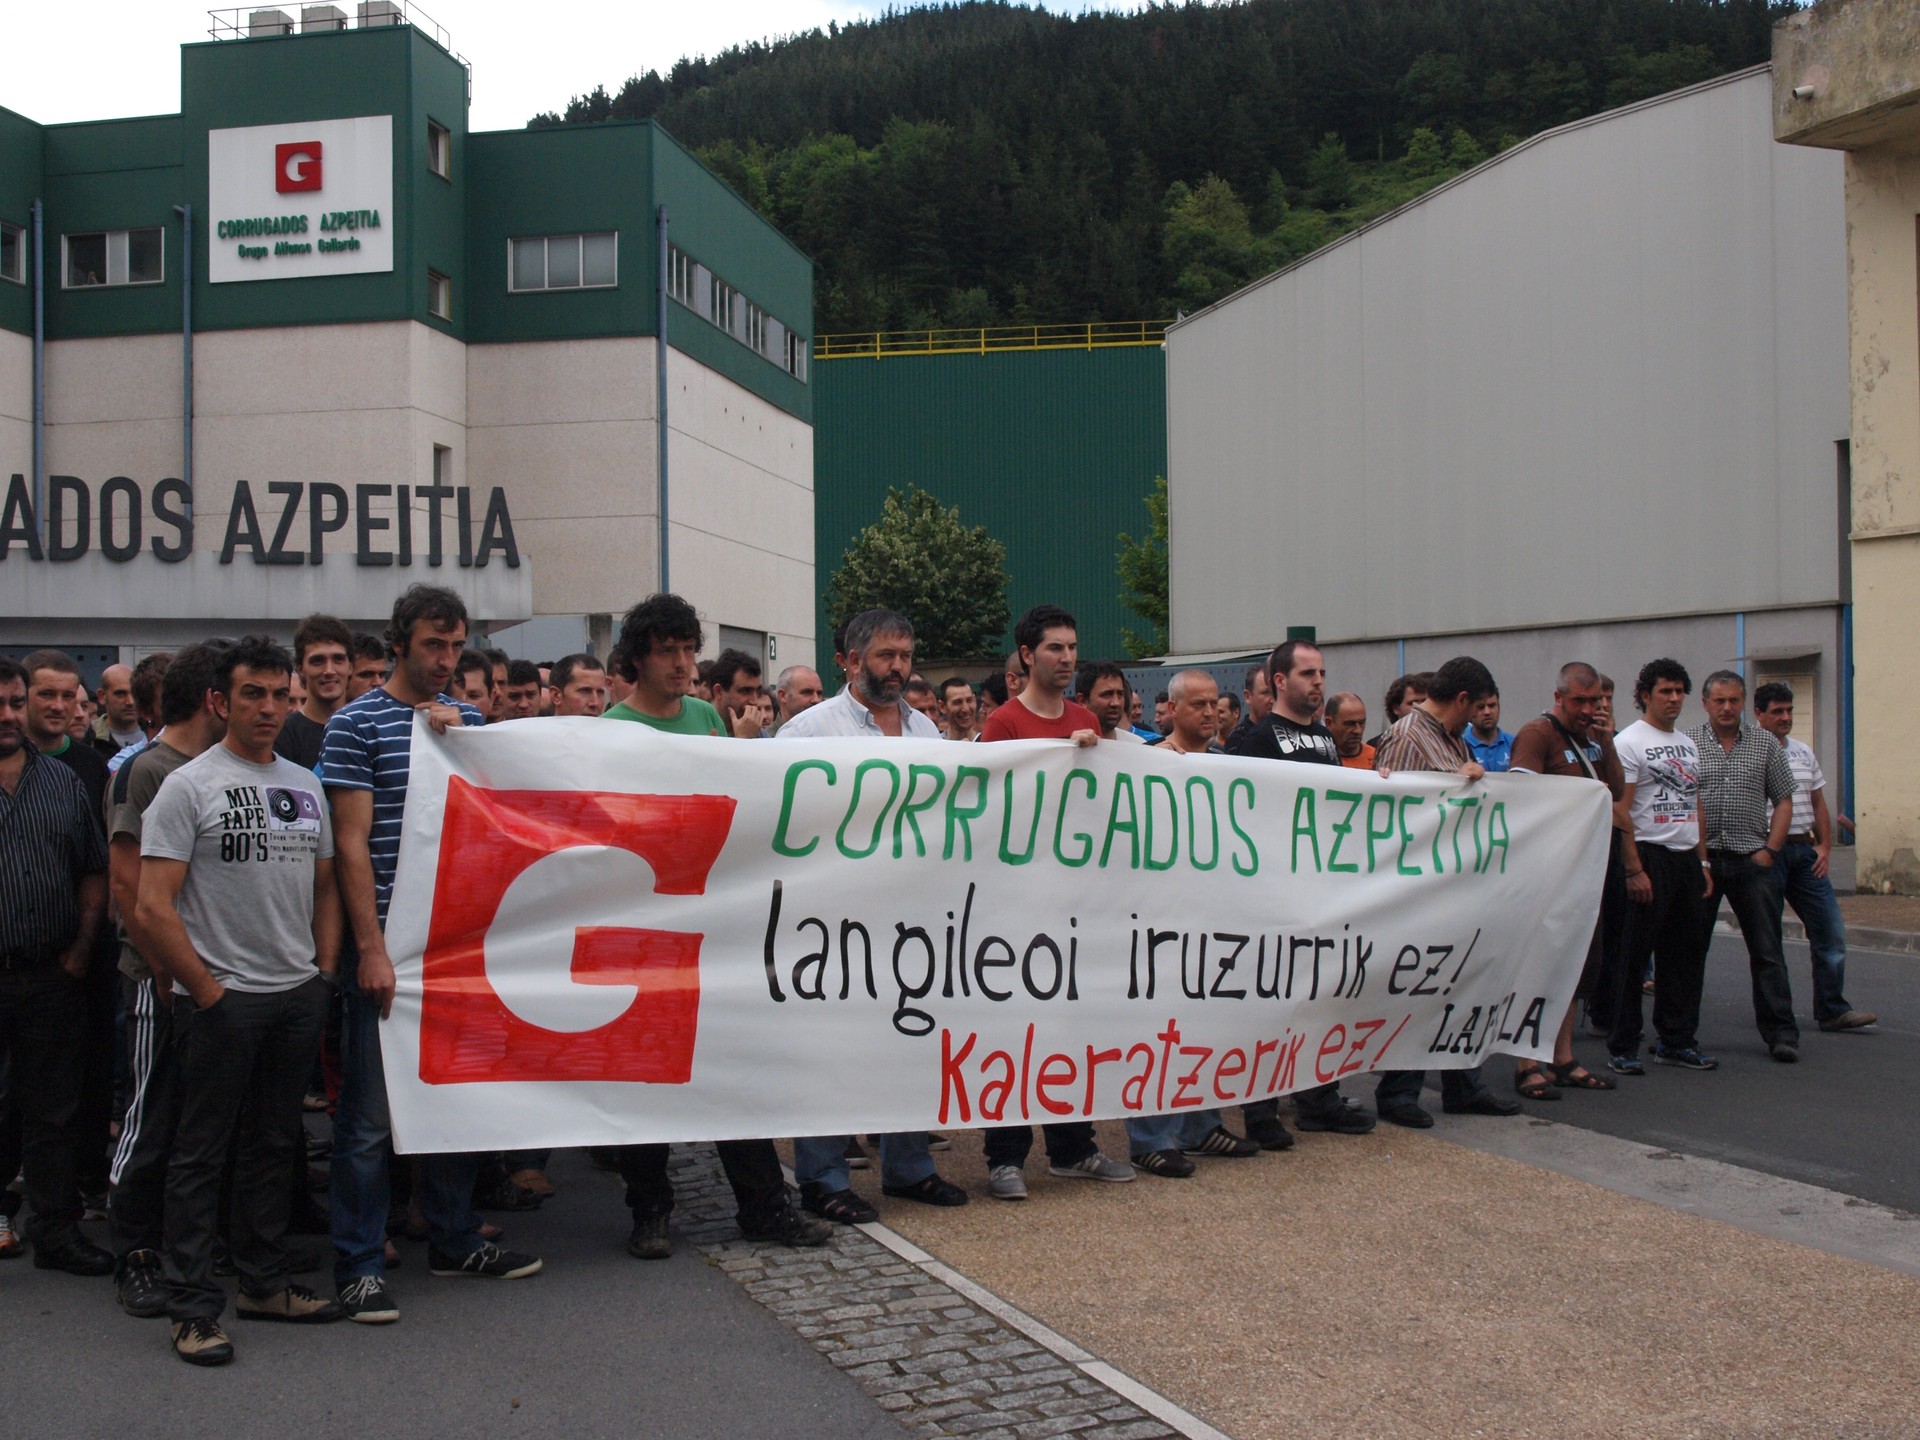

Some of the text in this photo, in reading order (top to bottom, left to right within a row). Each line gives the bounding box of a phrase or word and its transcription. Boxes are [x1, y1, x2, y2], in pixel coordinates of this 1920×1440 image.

[217, 209, 381, 240] CORRUGADOS AZPEITIA
[238, 237, 360, 260] Grupo Alfonso Gallardo
[0, 473, 520, 568] ADOS AZPEITIA
[220, 808, 268, 830] TAPE
[225, 785, 262, 809] MIX
[772, 758, 1261, 879] CORRUGADOS
[221, 832, 269, 863] 80'S
[419, 774, 738, 1085] G
[764, 879, 1481, 1036] langileoi iruzurrik ez!
[938, 1013, 1411, 1124] Kaleratzerik ez!
